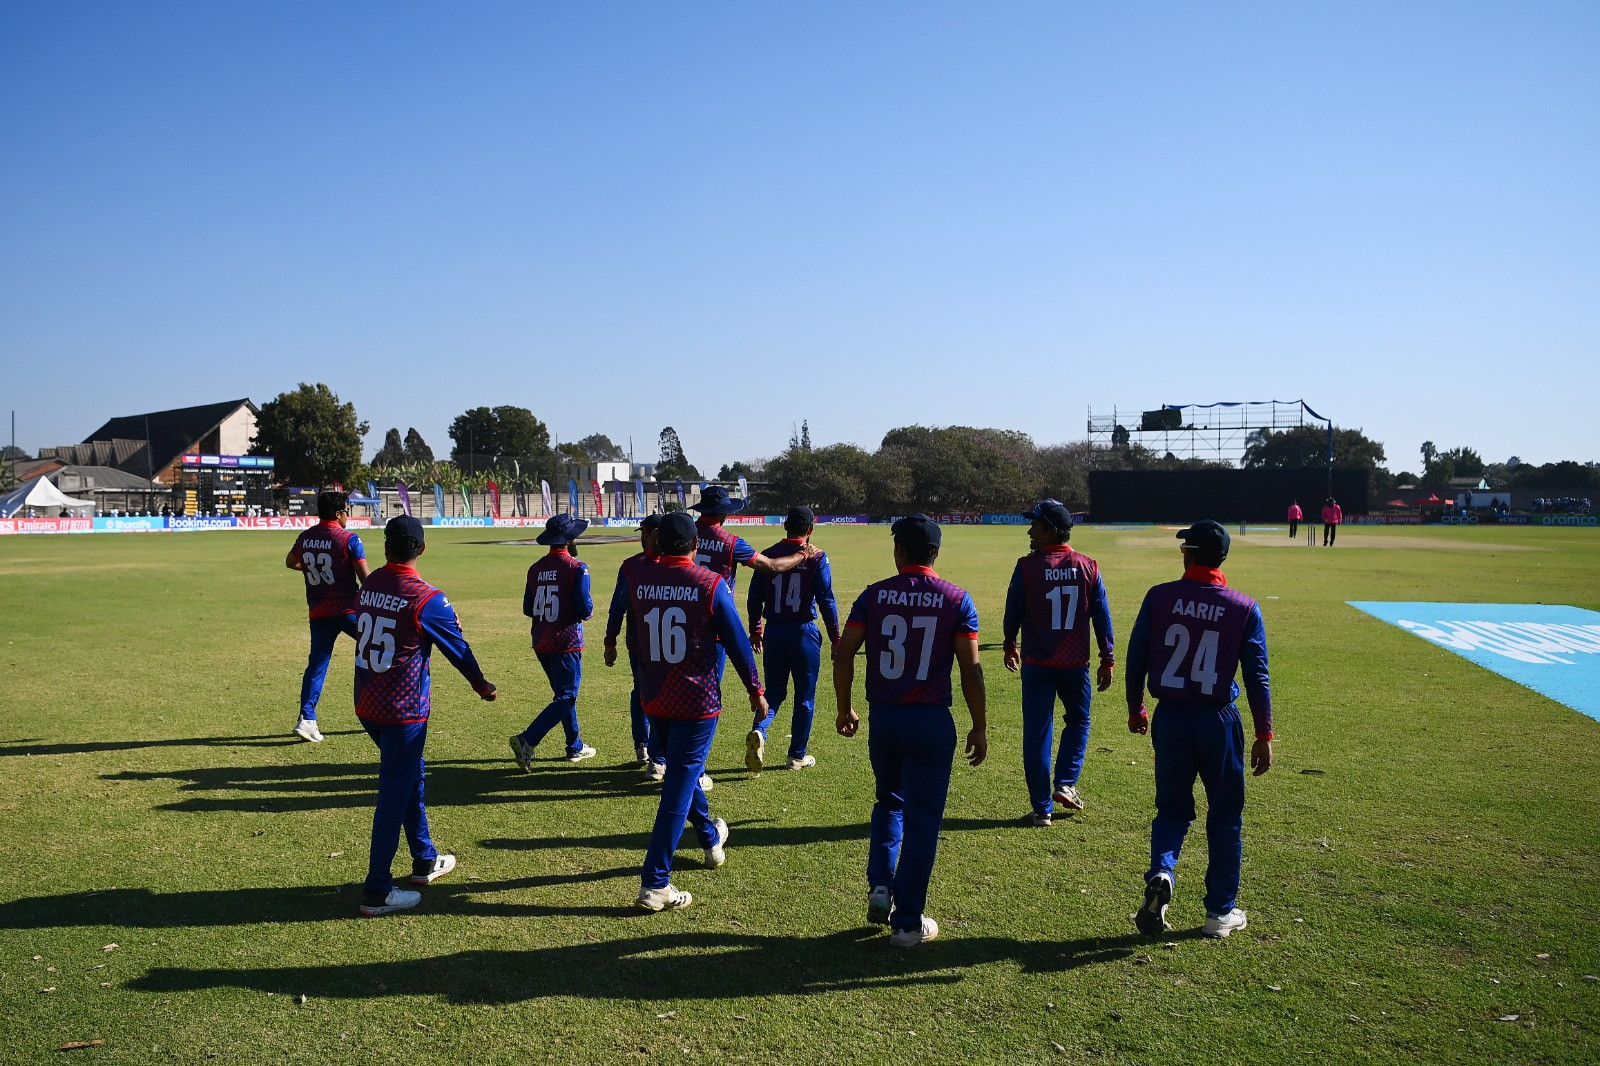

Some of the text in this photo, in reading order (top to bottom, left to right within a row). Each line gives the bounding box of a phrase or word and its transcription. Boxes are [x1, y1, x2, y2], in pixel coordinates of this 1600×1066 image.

[18, 520, 58, 531] Emirates
[116, 520, 152, 529] BharatPe
[169, 517, 231, 528] Booking.com
[236, 518, 306, 528] NISSAN
[440, 517, 486, 526] aramco
[931, 515, 983, 524] ISSAN
[1441, 515, 1479, 524] oppo
[1542, 515, 1597, 526] aramco
[303, 538, 332, 550] KARAN
[303, 552, 335, 586] 33
[537, 570, 558, 582] AIREE
[1045, 567, 1078, 581] ROHIT
[360, 590, 409, 613] SANDEEP
[637, 584, 699, 602] GYANENDRA
[772, 572, 801, 614] 14
[878, 589, 944, 609] PRATISH
[533, 585, 560, 623] 45
[1045, 586, 1079, 630] 17
[1172, 598, 1226, 622] AARIF
[355, 612, 396, 674] 25
[643, 606, 687, 664] 16
[880, 614, 938, 681] 37
[1160, 623, 1220, 695] 24
